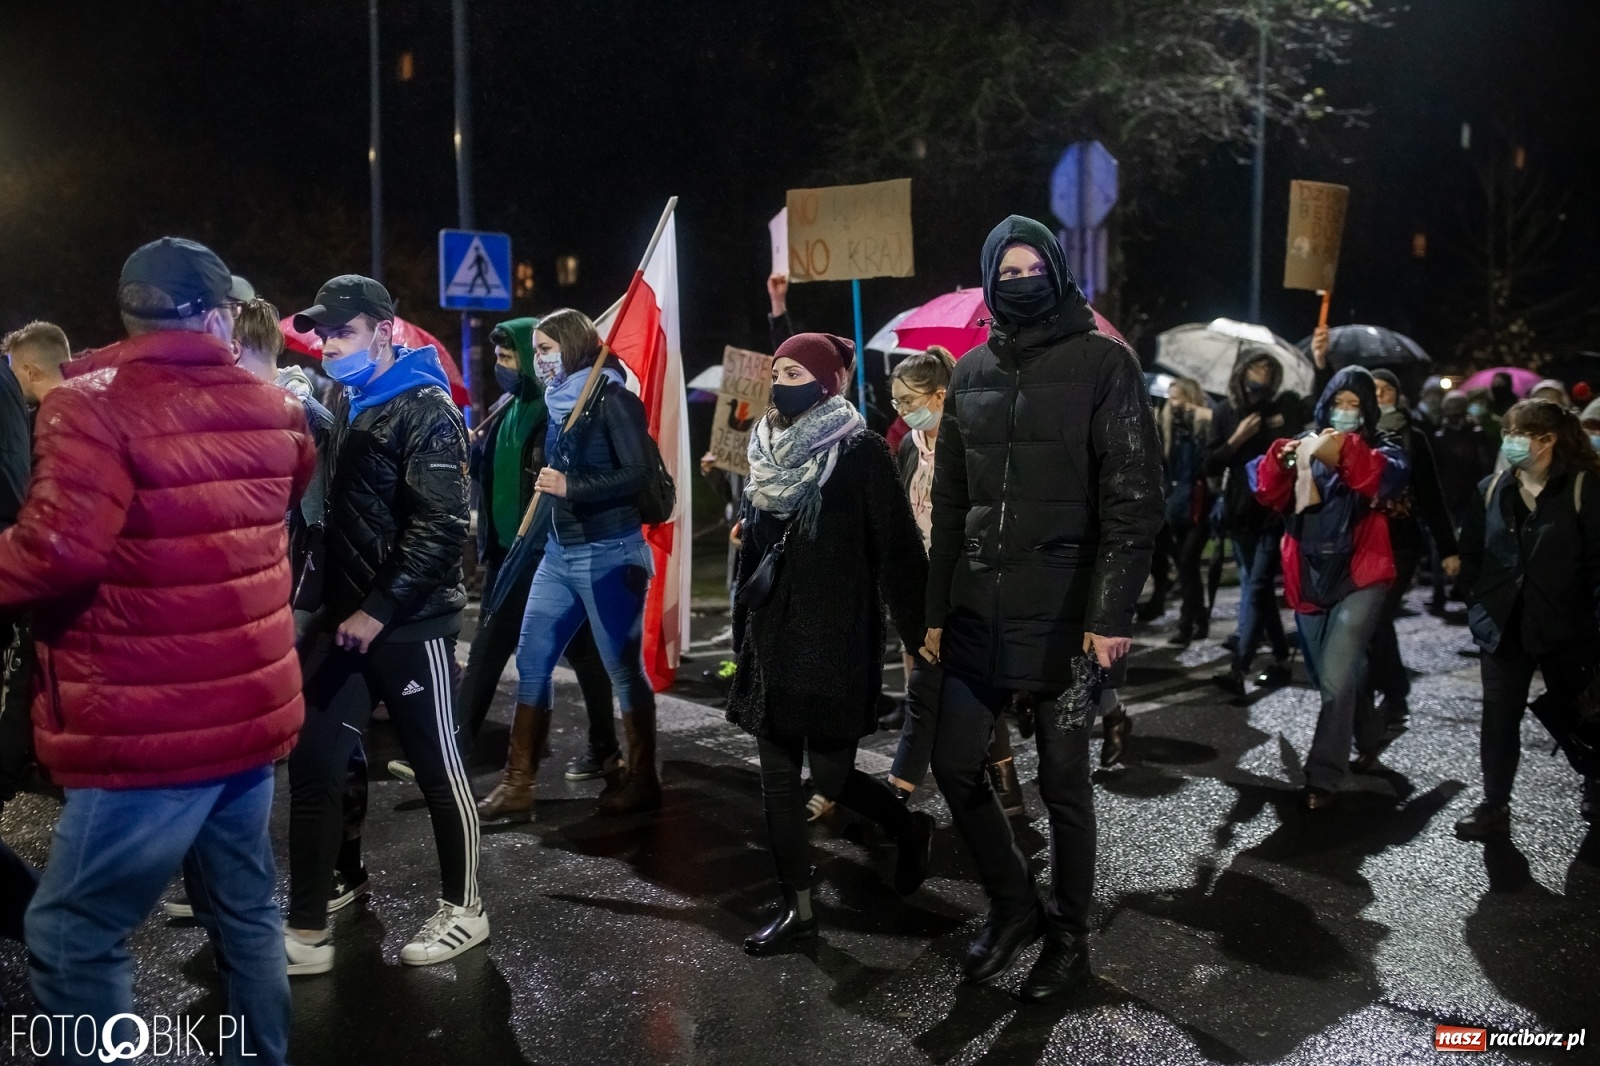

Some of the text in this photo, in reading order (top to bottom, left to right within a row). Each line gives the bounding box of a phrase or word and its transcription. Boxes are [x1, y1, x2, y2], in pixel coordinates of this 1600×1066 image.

[788, 193, 819, 226] NO
[789, 232, 903, 277] NO KRAJ
[726, 350, 769, 381] STARE
[716, 427, 748, 449] JEBA
[402, 686, 424, 696] adidas
